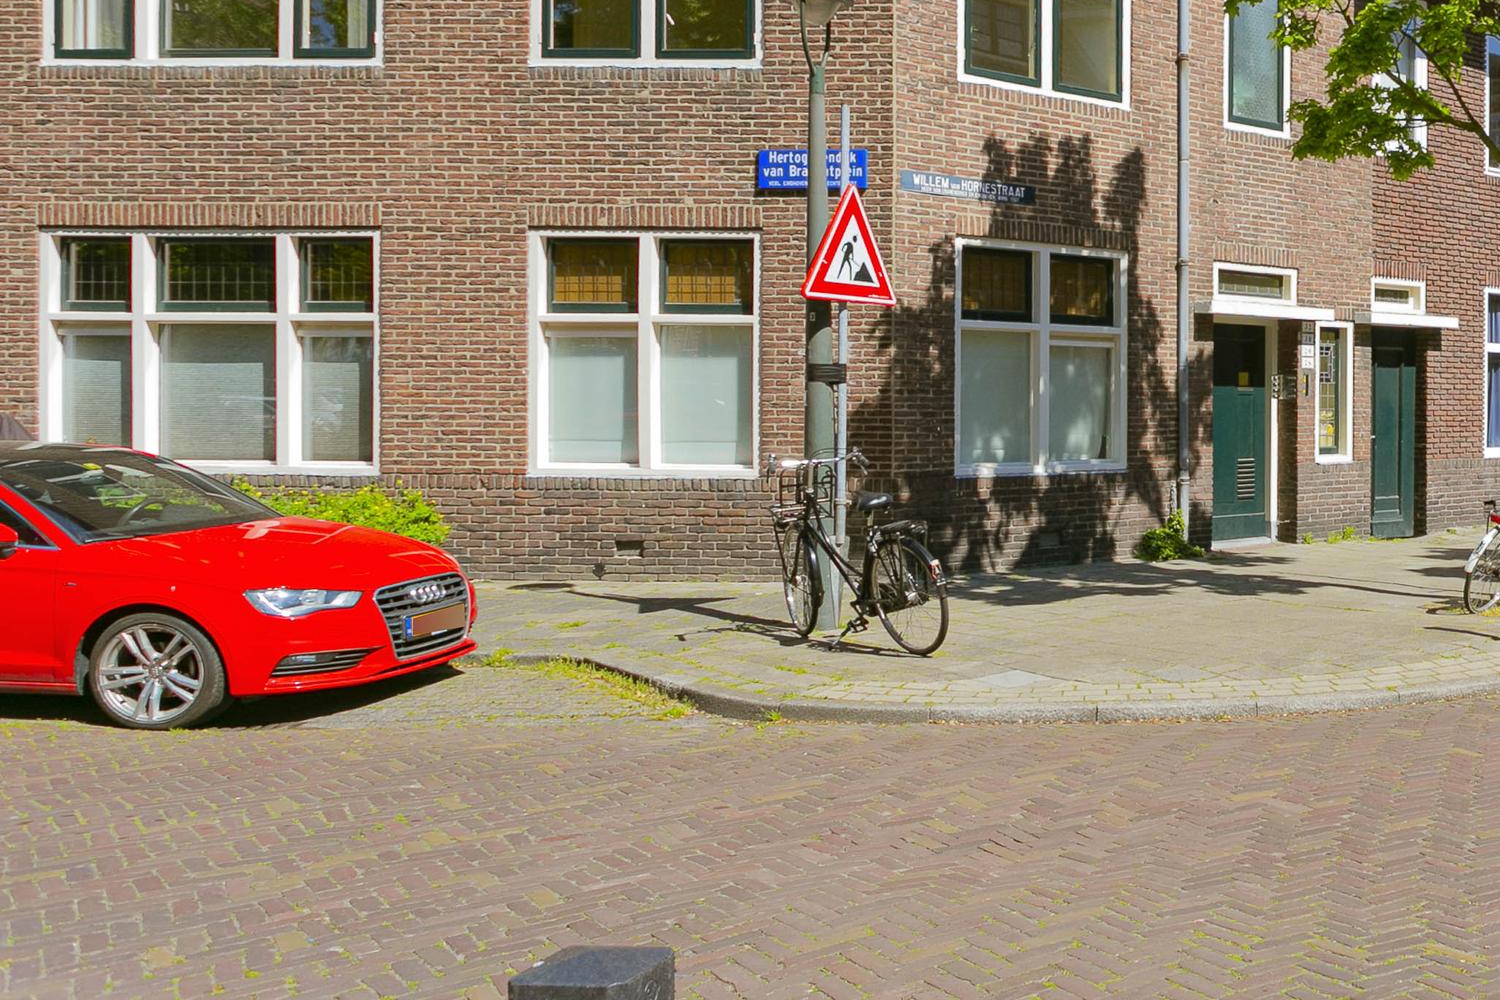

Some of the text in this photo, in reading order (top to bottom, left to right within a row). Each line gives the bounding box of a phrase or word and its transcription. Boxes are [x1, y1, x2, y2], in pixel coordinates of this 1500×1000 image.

[768, 151, 808, 165] Hertog
[763, 167, 784, 177] van
[913, 173, 950, 189] WILLEM
[961, 179, 1026, 198] HORNESTRAAT
